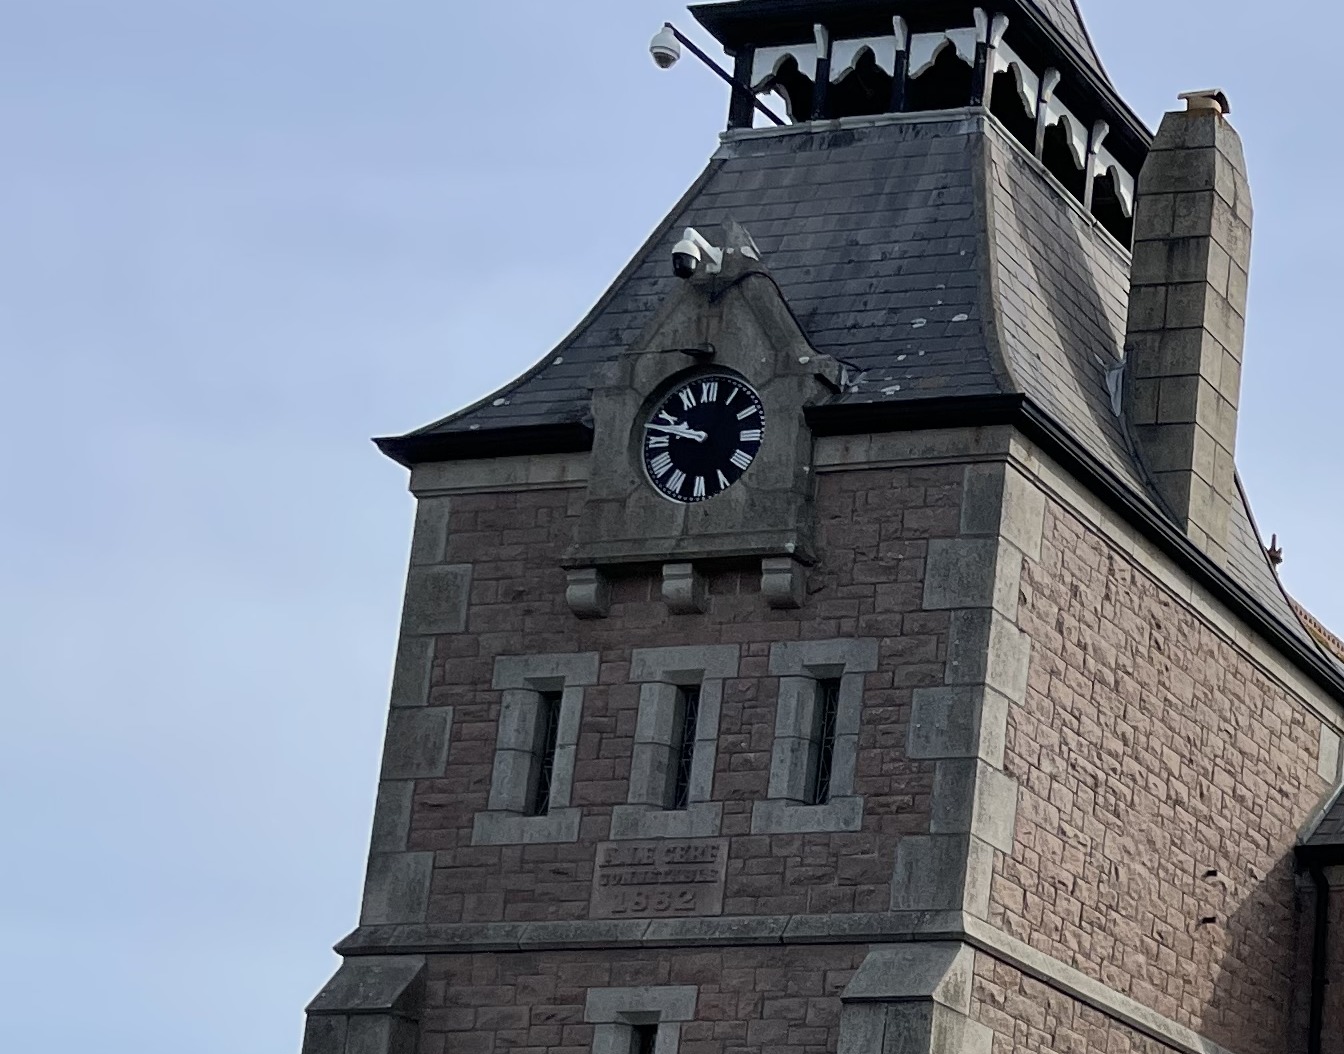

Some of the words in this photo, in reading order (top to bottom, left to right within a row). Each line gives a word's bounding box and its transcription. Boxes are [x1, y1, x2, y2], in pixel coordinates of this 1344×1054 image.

[679, 386, 696, 411] XI
[701, 382, 718, 403] XII
[736, 405, 757, 420] II
[740, 429, 761, 442] III
[716, 469, 730, 490] V
